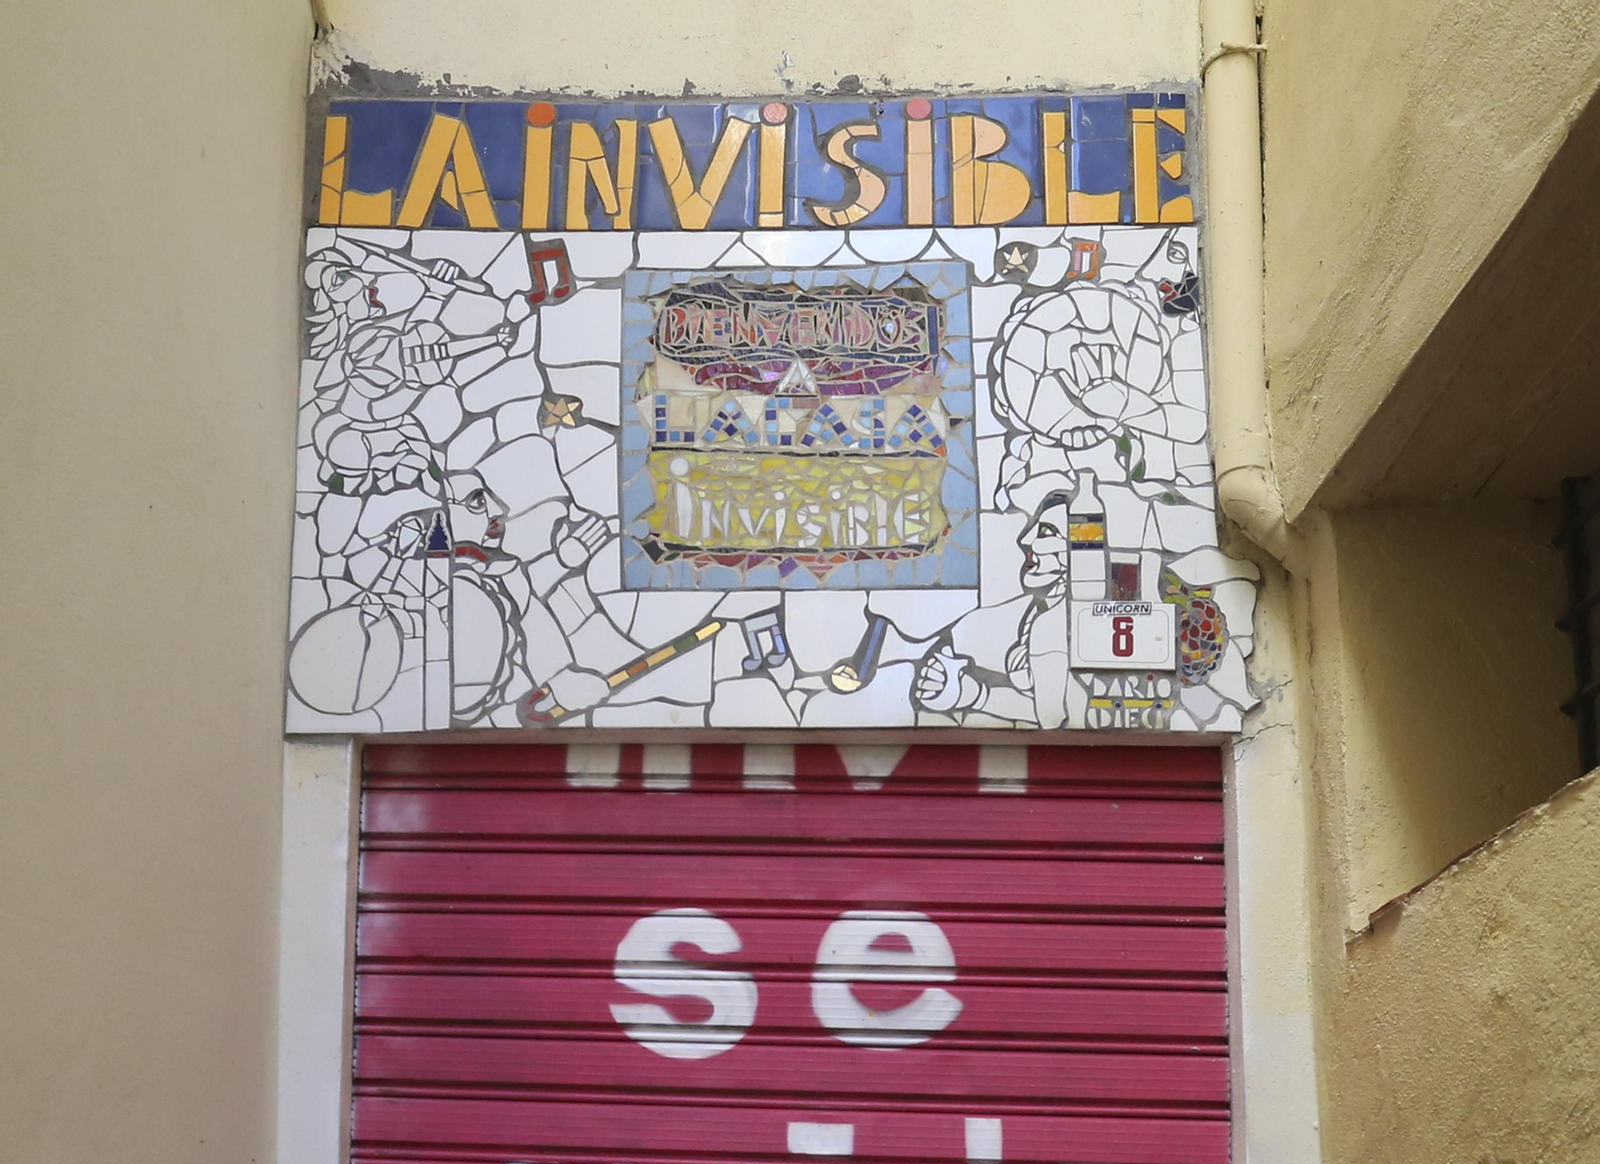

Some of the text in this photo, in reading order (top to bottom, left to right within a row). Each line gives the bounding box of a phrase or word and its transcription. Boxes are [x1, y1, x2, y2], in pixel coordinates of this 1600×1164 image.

[1095, 604, 1149, 614] UNICORN
[1112, 616, 1134, 657] 8
[608, 908, 964, 1059] se
